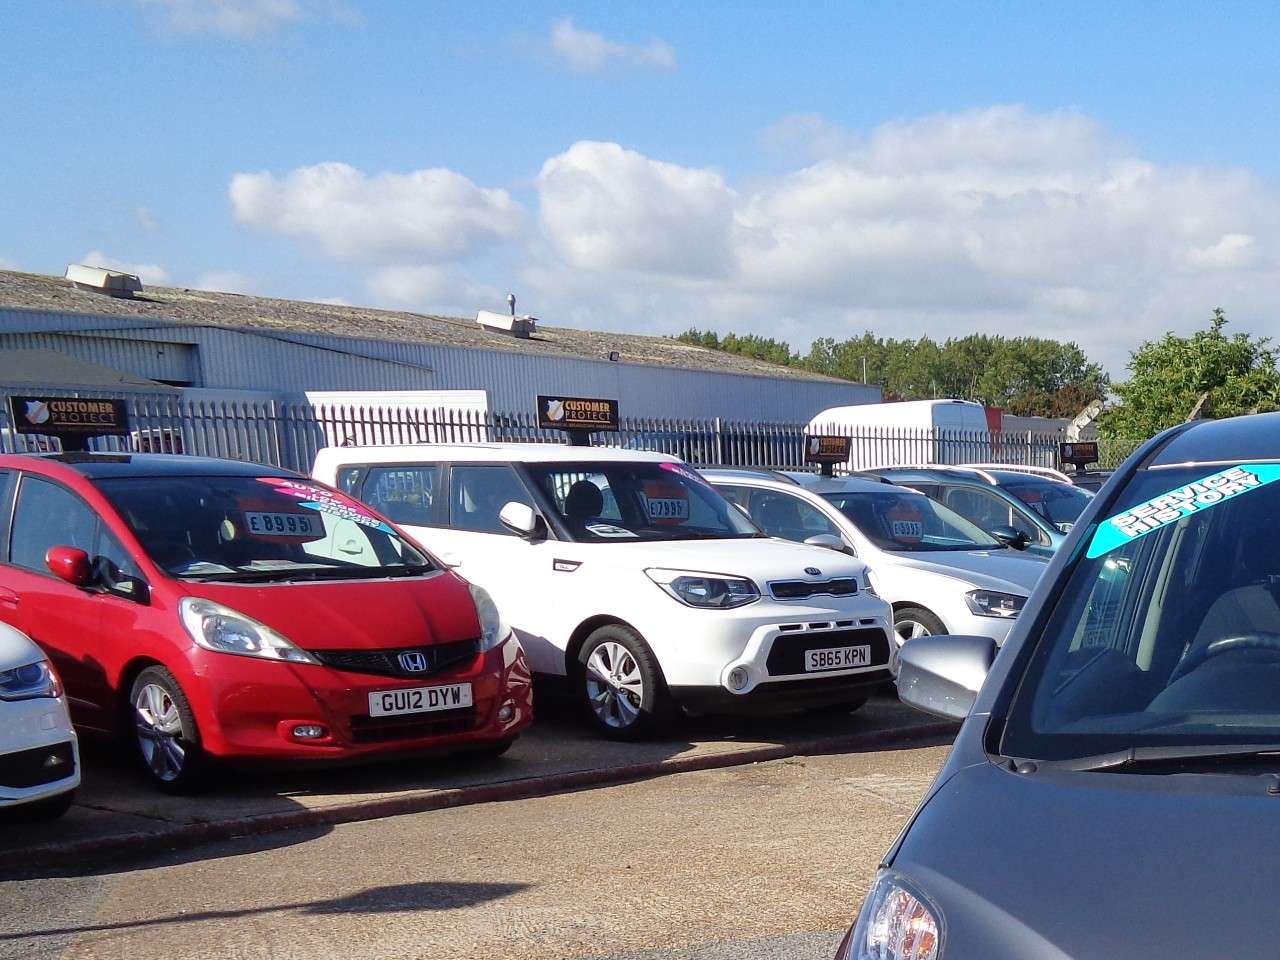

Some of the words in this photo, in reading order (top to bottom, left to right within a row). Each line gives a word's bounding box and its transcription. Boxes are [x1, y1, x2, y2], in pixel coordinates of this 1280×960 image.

[51, 402, 113, 413] CUSTOMER
[565, 400, 609, 412] CUSTOMER
[51, 413, 116, 422] PROTECT
[565, 411, 610, 420] PROTECT
[1110, 468, 1248, 528] SERVICE
[1120, 473, 1263, 538] HISTORY
[811, 650, 841, 667] SB65
[844, 648, 866, 664] KPN
[382, 690, 423, 711] GU12
[428, 686, 460, 707] DYW
